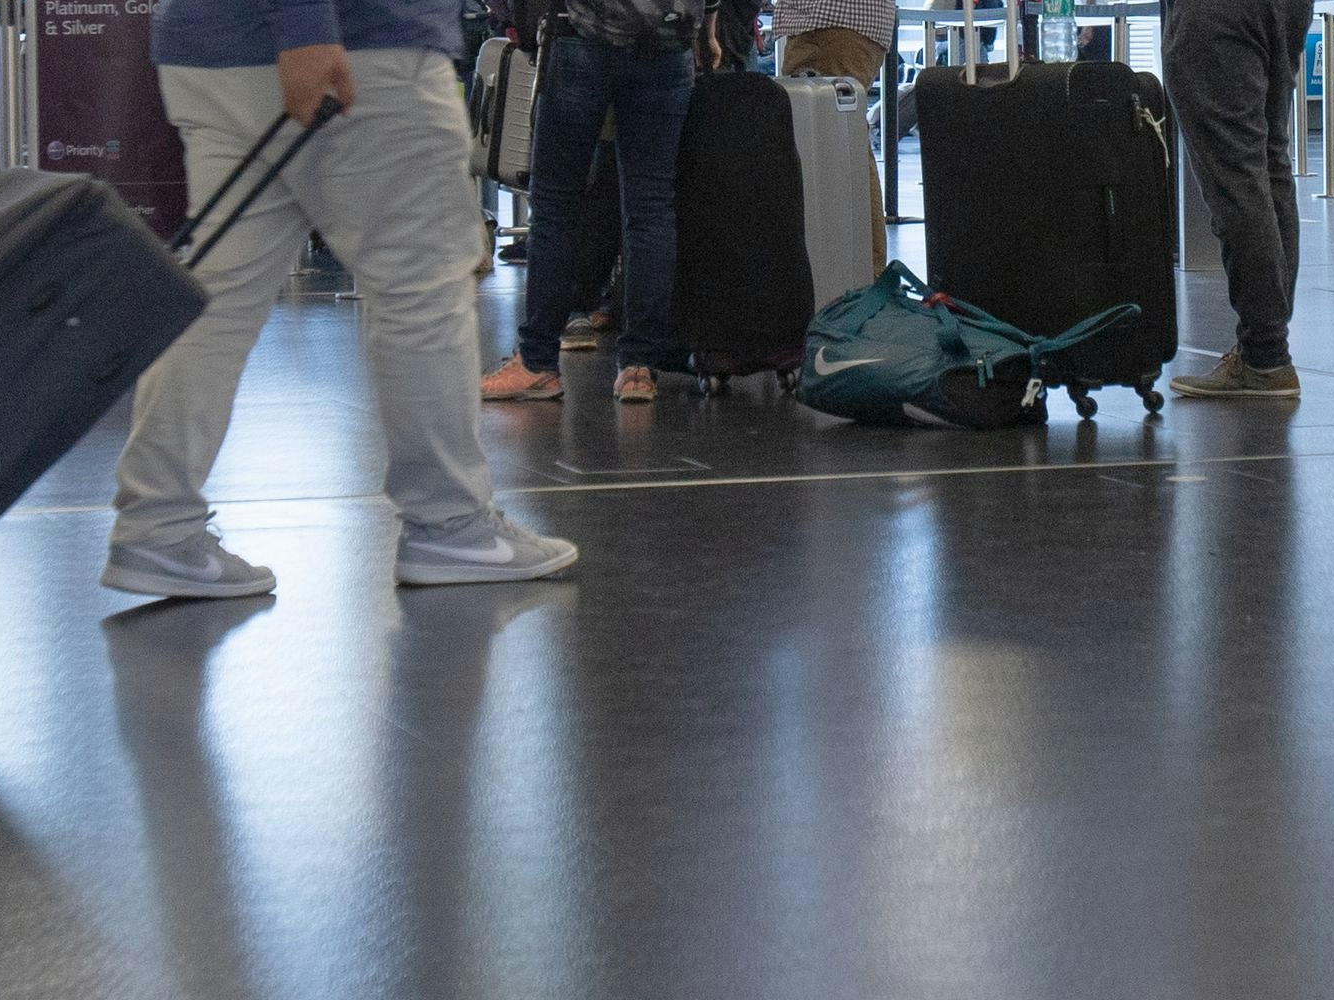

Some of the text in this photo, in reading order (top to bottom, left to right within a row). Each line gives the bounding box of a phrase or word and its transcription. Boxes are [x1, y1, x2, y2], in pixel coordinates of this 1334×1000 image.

[45, 1, 119, 17] Platinum,
[45, 19, 106, 36] & Silver
[66, 144, 105, 158] Priority
